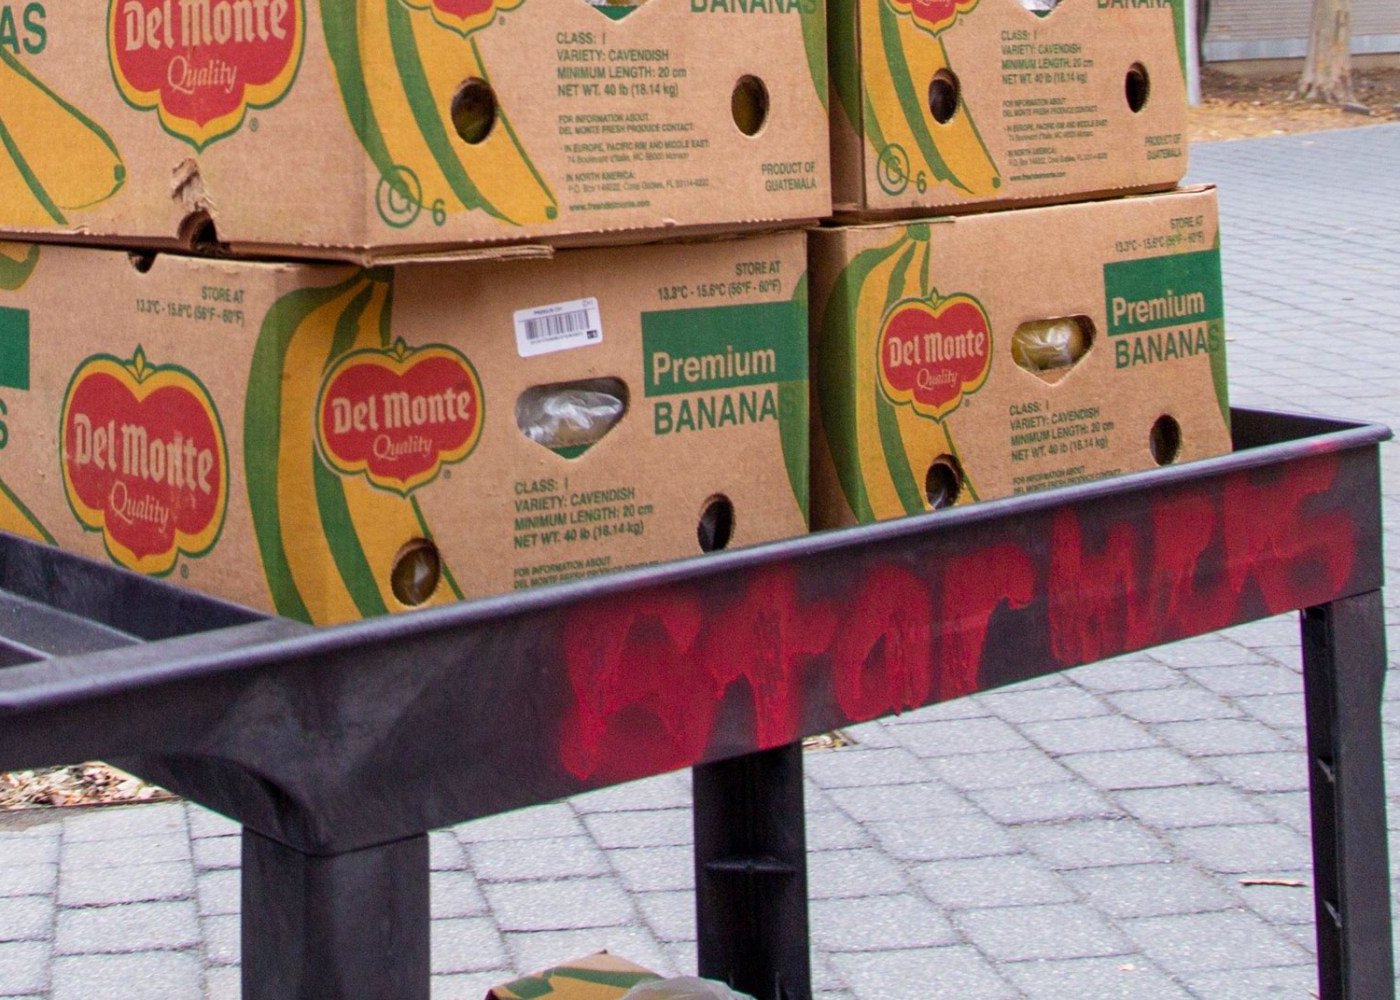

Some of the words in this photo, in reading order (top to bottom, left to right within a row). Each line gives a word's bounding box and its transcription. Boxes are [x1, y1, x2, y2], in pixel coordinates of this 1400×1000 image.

[556, 32, 596, 44] CLASS:
[1001, 30, 1030, 40] CLASS:
[557, 49, 606, 62] VARIETY:
[608, 49, 669, 61] CAVENDISH
[166, 55, 237, 95] Quality
[557, 67, 606, 79] MINIMUM
[609, 66, 655, 78] LENGTH:
[658, 67, 670, 78] 20
[673, 68, 687, 78] cm
[558, 84, 579, 97] NET
[604, 84, 616, 96] 40
[619, 84, 629, 96] lb
[663, 83, 679, 98] kg)
[575, 114, 623, 123] INFORMATION
[625, 113, 648, 122] ABOUT
[559, 126, 573, 135] DEL
[762, 161, 802, 175] PRODUCT
[805, 161, 815, 173] OF
[765, 177, 816, 192] GUATEMALA
[916, 171, 927, 194] 6
[432, 198, 446, 227] 6
[736, 262, 767, 276] STORE
[769, 261, 781, 274] AT
[201, 286, 231, 303] STORE
[233, 289, 244, 304] AT
[1112, 289, 1205, 327] Premium
[887, 335, 921, 368] Del
[924, 331, 985, 363] Monte
[1115, 323, 1221, 369] BANANAS
[653, 345, 775, 386] Premium
[916, 367, 958, 391] Quality
[332, 391, 377, 434] Del
[382, 386, 471, 428] Monte
[1010, 401, 1041, 416] CLASS:
[1010, 416, 1049, 431] VARIETY:
[1051, 407, 1099, 424] CAVENDISH
[1011, 430, 1050, 446] MINIMUM
[1052, 424, 1089, 439] LENGTH:
[74, 413, 117, 474] Del
[121, 424, 213, 494] Monte
[372, 434, 432, 462] Quality
[1011, 449, 1028, 460] NET
[515, 479, 558, 495] CLASS:
[109, 482, 169, 528] Quality
[515, 496, 567, 513] VARIETY:
[570, 487, 635, 507] CAVENDISH
[515, 512, 566, 531] MINIMUM
[570, 507, 619, 524] LENGTH:
[623, 504, 635, 518] 20
[638, 504, 654, 515] cm
[514, 534, 537, 549] NET
[564, 529, 577, 542] 40
[580, 528, 590, 540] lb
[627, 520, 644, 536] kg)
[514, 568, 530, 578] FOR
[532, 561, 584, 575] INFORMATION
[586, 556, 611, 568] ABOUT
